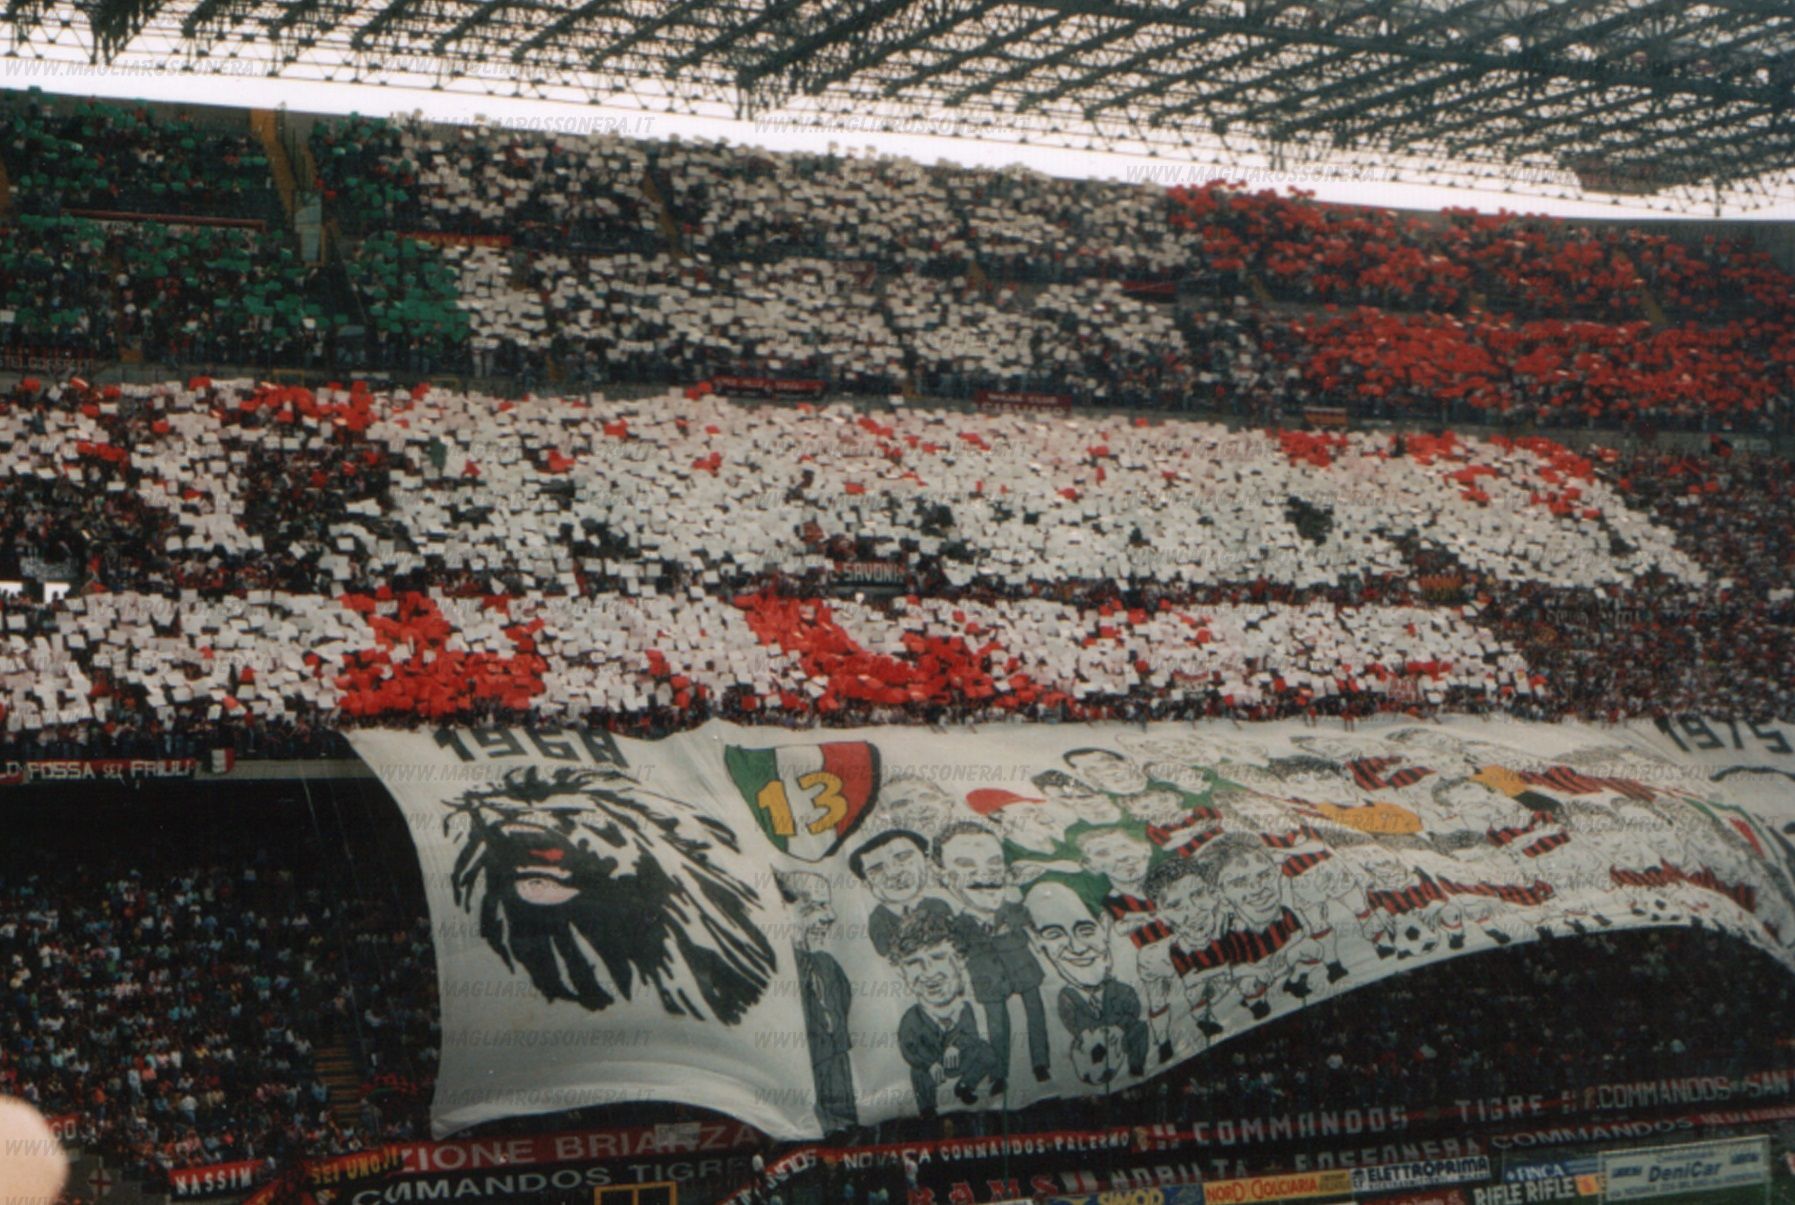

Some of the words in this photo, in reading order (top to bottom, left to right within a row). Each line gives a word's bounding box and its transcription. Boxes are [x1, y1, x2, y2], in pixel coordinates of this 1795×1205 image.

[433, 727, 630, 769] 1968
[1653, 712, 1794, 754] 1975
[27, 761, 96, 780] FOSSA
[757, 771, 849, 836] 13
[1192, 1105, 1409, 1146] COMMANDOS
[1454, 1094, 1545, 1123] TIGRE
[1491, 1115, 1694, 1150] COMMANDOS
[1368, 1157, 1489, 1182] ELETTROPRIMA
[1648, 1160, 1722, 1183] DeniCar
[1206, 1182, 1245, 1202] NORD
[1473, 1183, 1522, 1205] RIFLE
[1524, 1176, 1575, 1203] RIFLE
